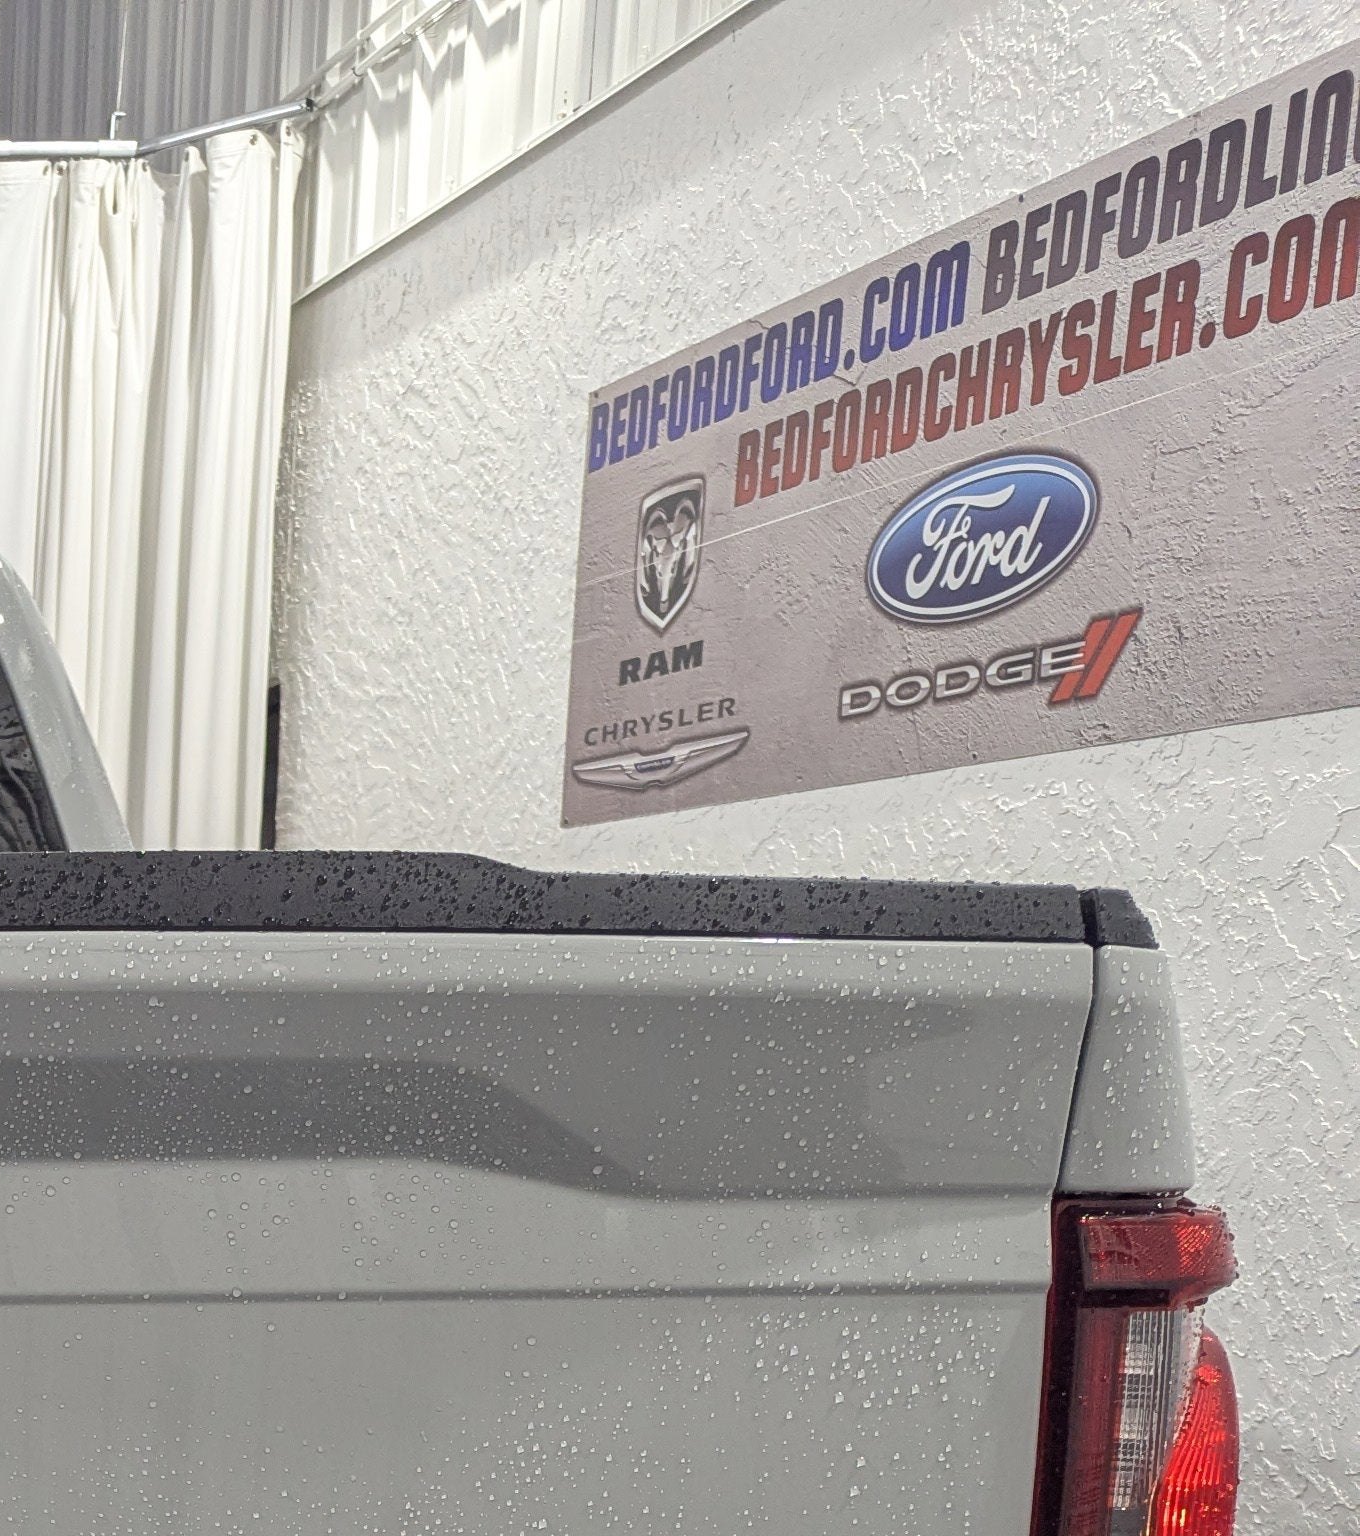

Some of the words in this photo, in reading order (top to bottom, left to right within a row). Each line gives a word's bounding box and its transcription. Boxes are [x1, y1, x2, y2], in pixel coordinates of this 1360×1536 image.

[588, 240, 971, 474] BEDFORDFORD.COM
[981, 69, 1360, 316] BEDFORDLIN
[905, 483, 1052, 600] Ford
[618, 639, 704, 687] RAM
[840, 640, 1086, 717] DODGE
[583, 697, 737, 747] CHRYSLER
